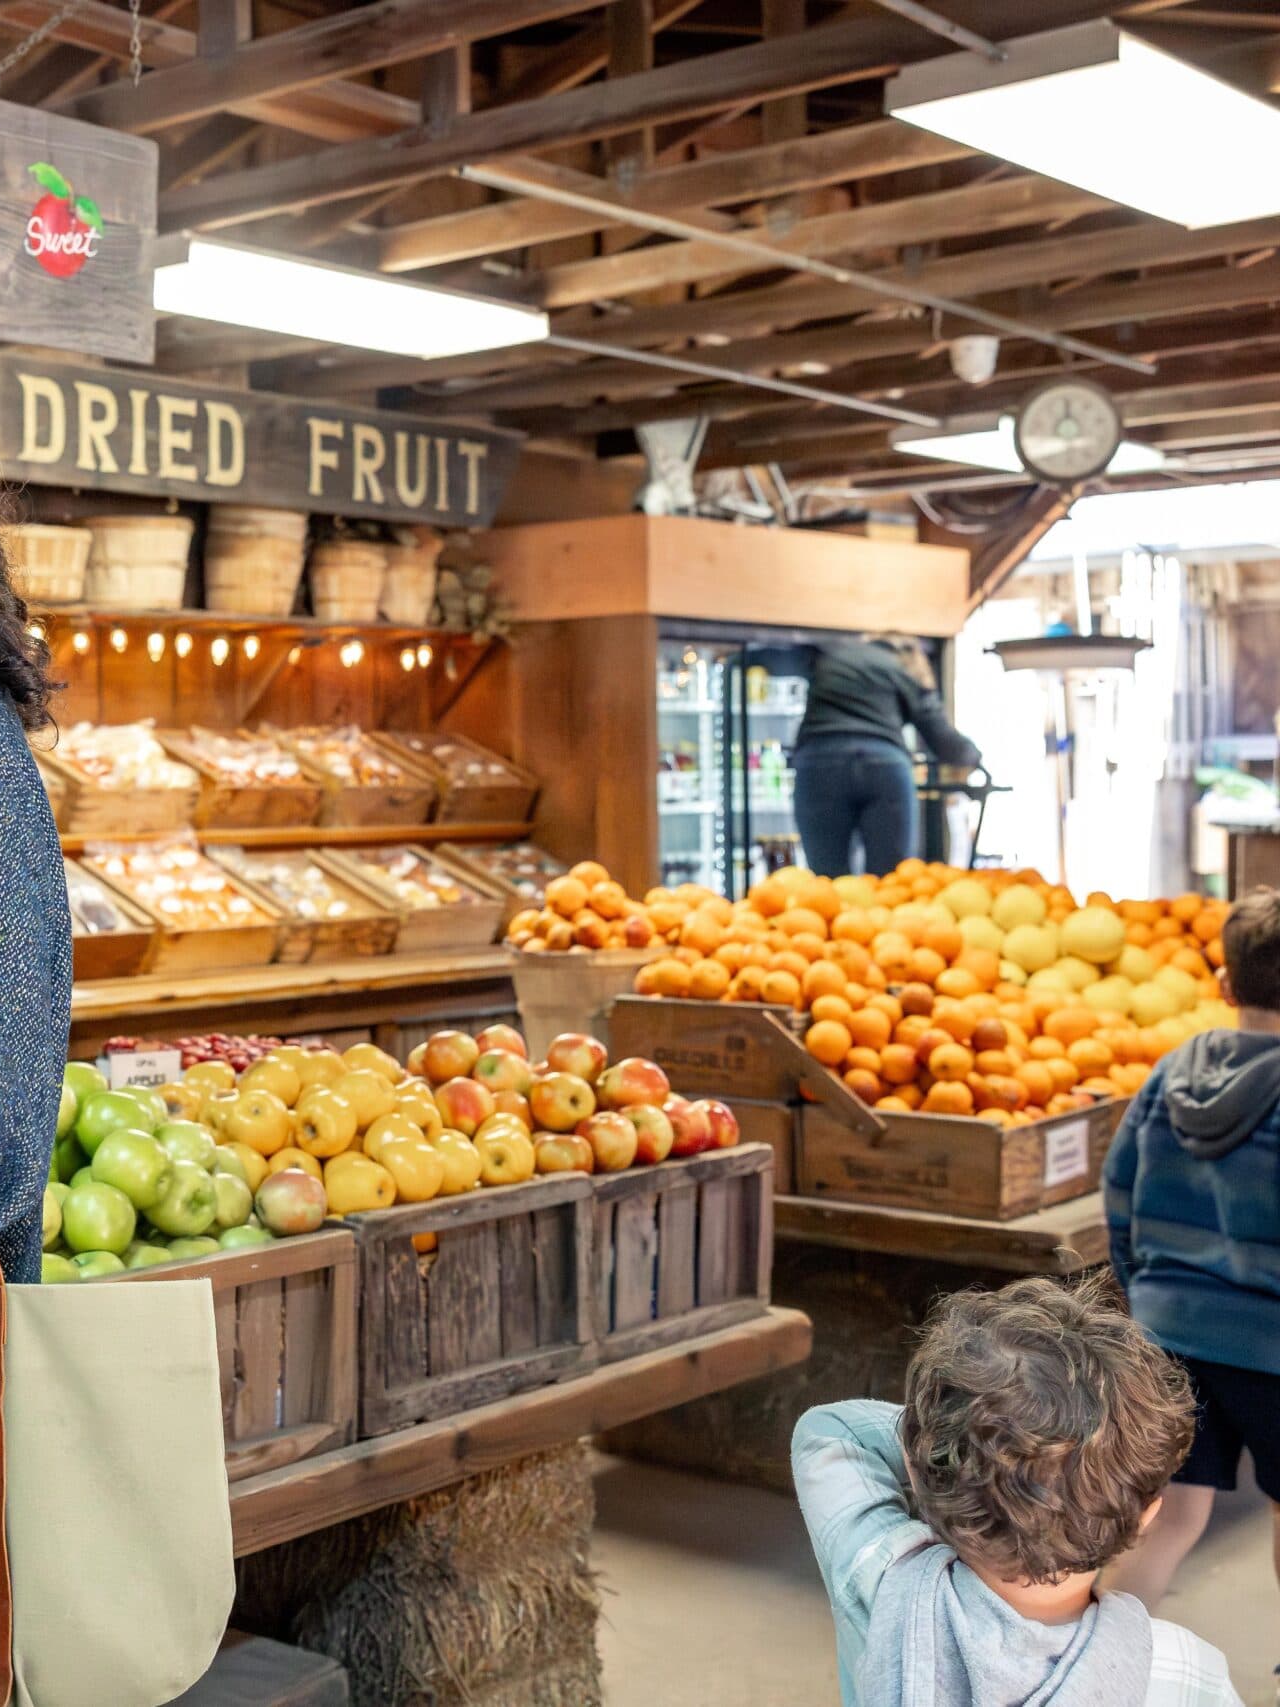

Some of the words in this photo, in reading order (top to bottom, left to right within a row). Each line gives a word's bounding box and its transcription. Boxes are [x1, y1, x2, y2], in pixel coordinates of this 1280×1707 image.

[24, 216, 103, 257] Sweet
[17, 373, 245, 487] DRIED
[306, 416, 489, 515] FRUIT
